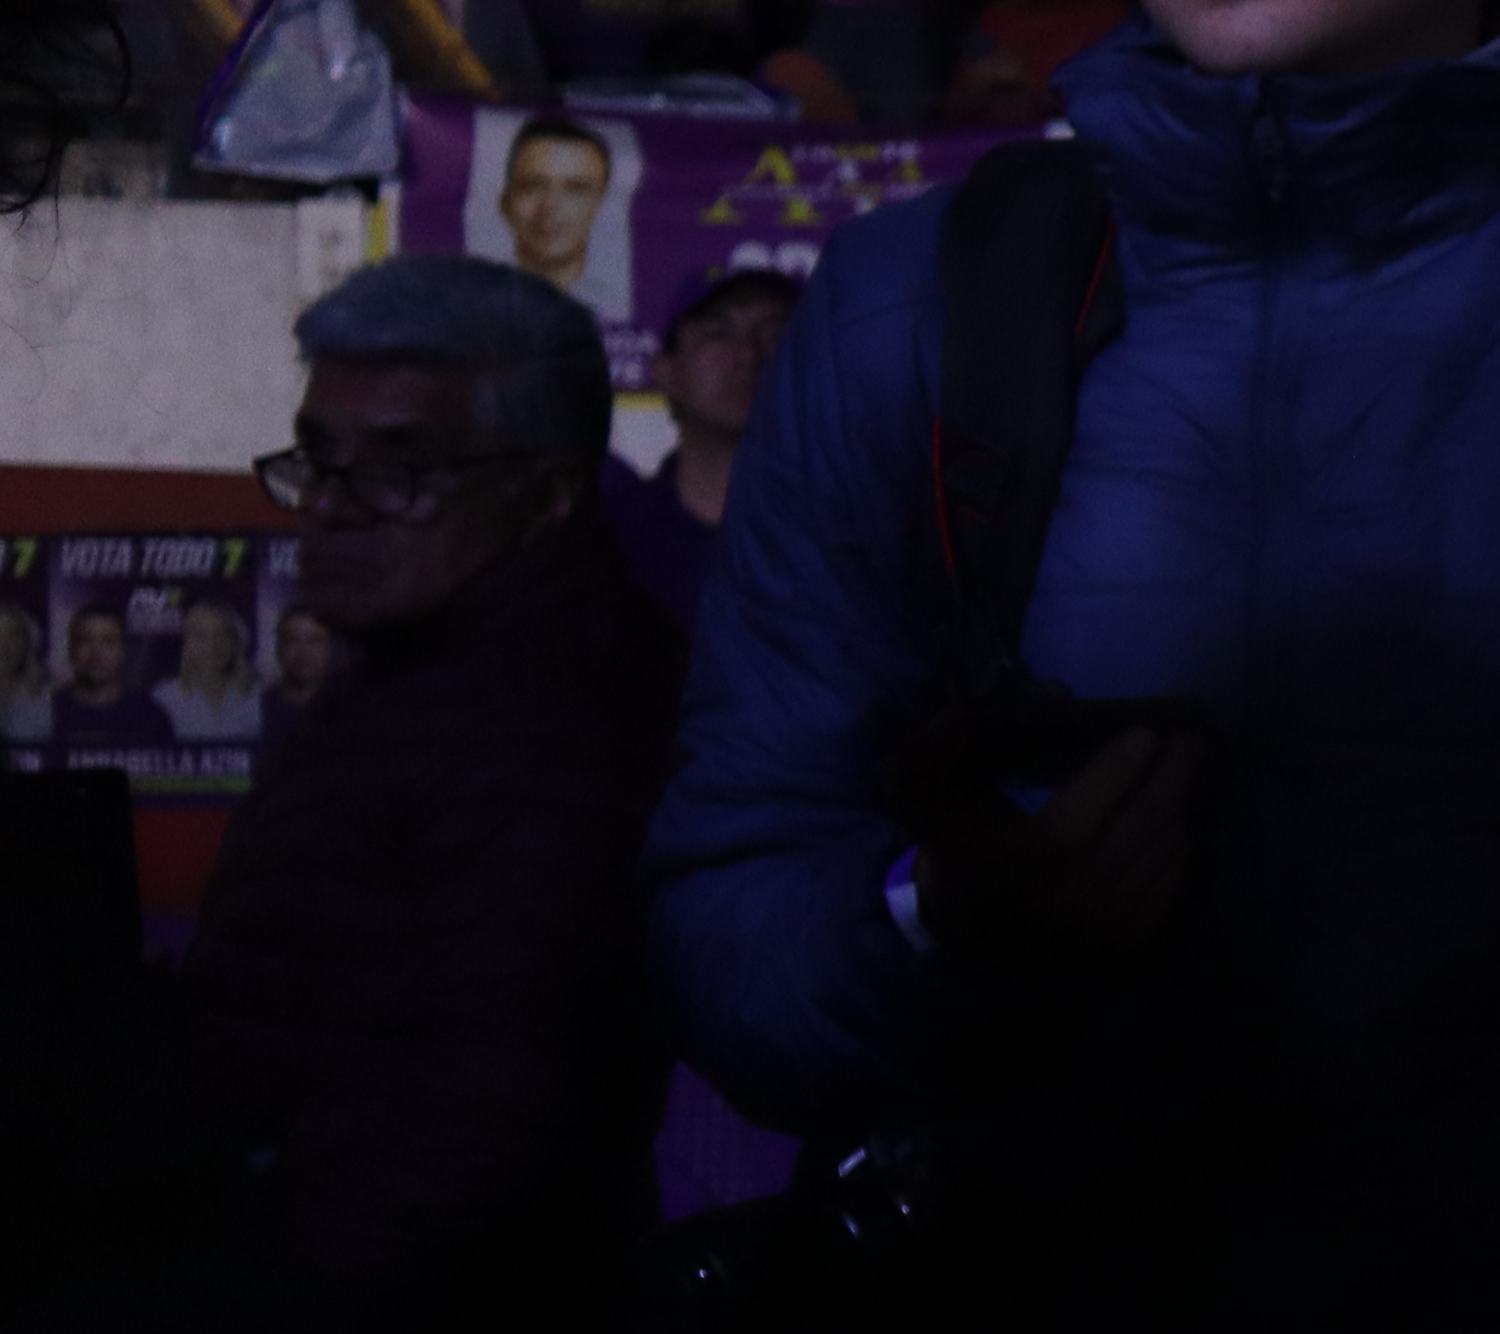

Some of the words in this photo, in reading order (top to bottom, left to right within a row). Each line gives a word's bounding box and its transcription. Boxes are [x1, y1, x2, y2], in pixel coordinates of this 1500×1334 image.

[59, 536, 134, 578] VOTA
[140, 536, 217, 578] TODO
[221, 536, 249, 578] 7
